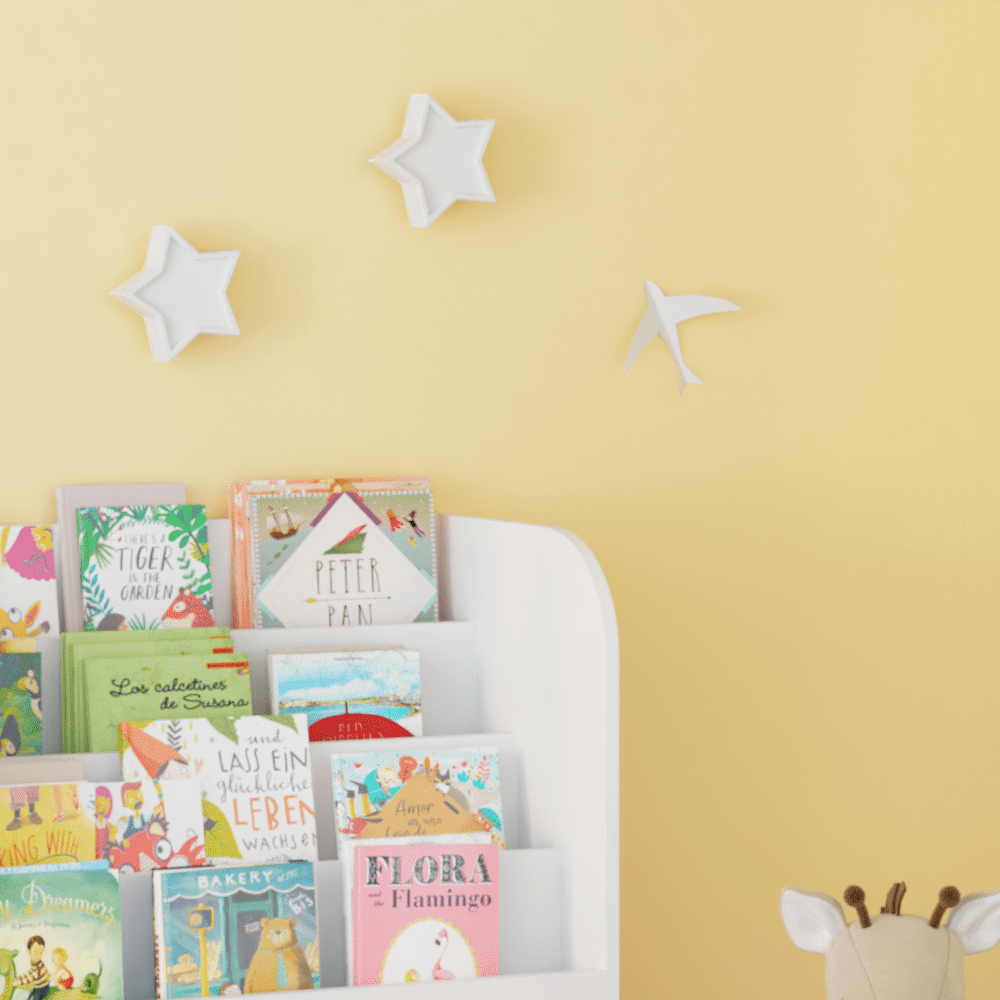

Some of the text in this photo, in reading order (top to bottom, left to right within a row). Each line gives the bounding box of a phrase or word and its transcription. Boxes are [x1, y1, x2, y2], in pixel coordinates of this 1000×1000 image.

[115, 545, 174, 571] TIGER
[143, 572, 160, 583] THE
[316, 557, 381, 595] PETER
[120, 584, 174, 601] GARDEN
[327, 604, 373, 627] PAN
[109, 677, 228, 697] Los calcetines
[160, 693, 249, 710] de Susana
[245, 729, 285, 745] und
[217, 748, 261, 773] LASS
[232, 795, 316, 832] LEBEN
[198, 870, 273, 888] BAKERY
[364, 854, 494, 887] FLORA
[19, 880, 115, 923] Dreamers
[392, 888, 492, 913] Flamingo
